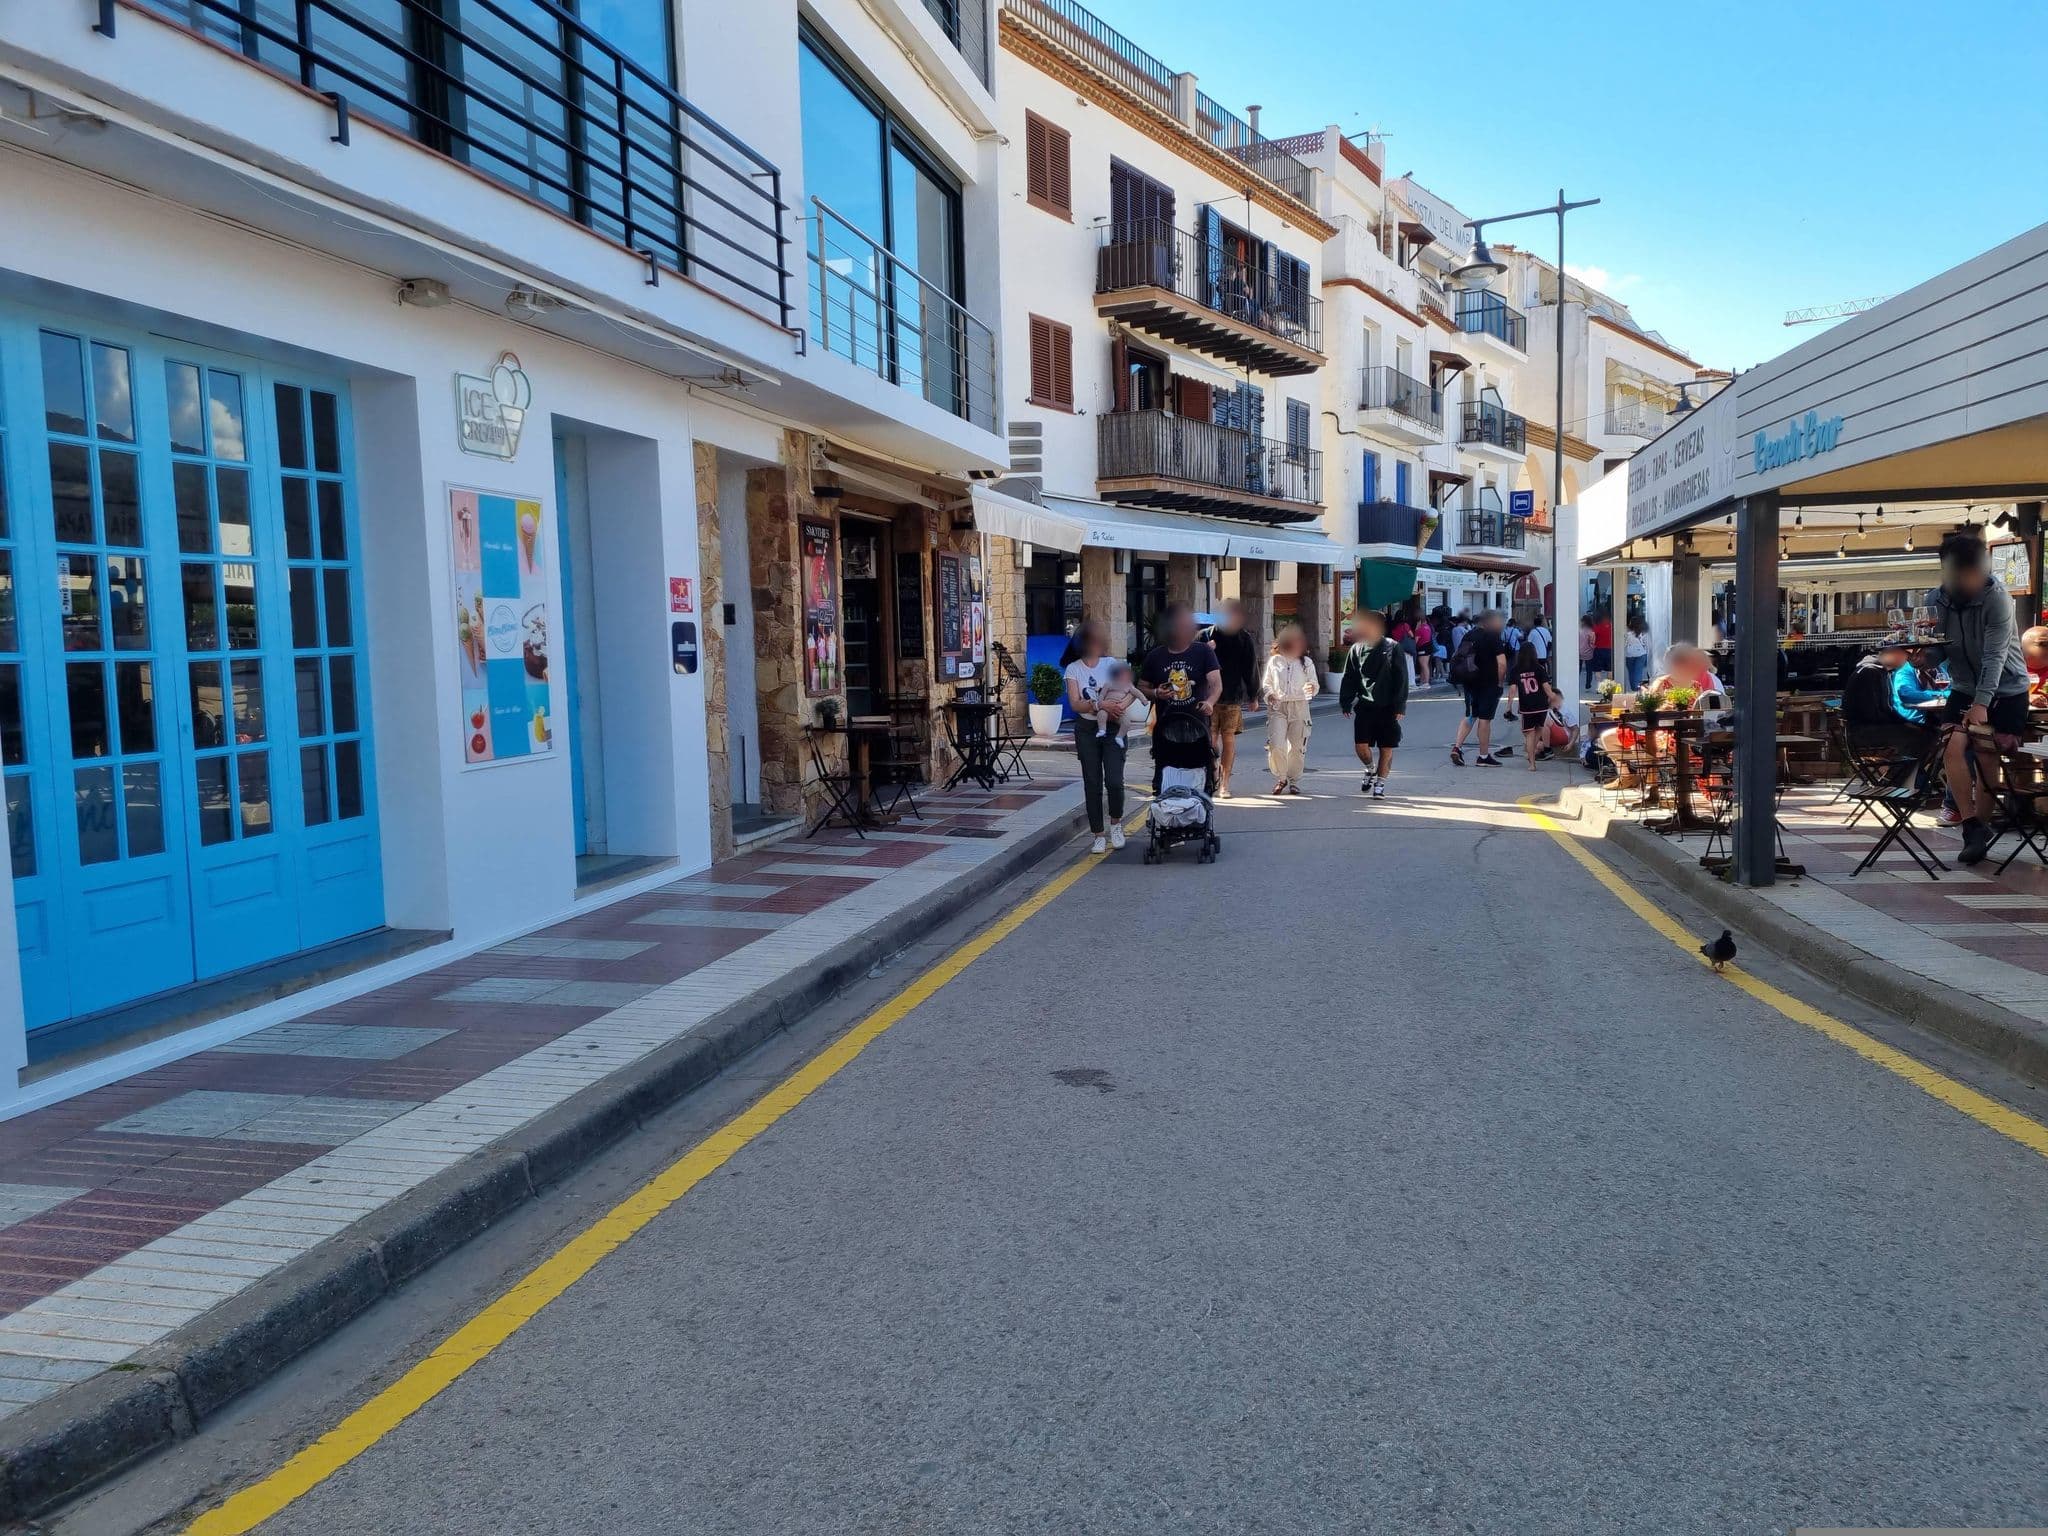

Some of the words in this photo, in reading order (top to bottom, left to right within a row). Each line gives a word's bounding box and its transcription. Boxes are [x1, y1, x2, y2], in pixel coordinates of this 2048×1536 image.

[1440, 216, 1453, 240] DEL
[1456, 228, 1471, 248] MAR
[463, 387, 494, 421] ICE
[1653, 450, 1668, 482] TAPAS
[1675, 424, 1705, 469] CERVEZAS
[1520, 677, 1539, 695] 10
